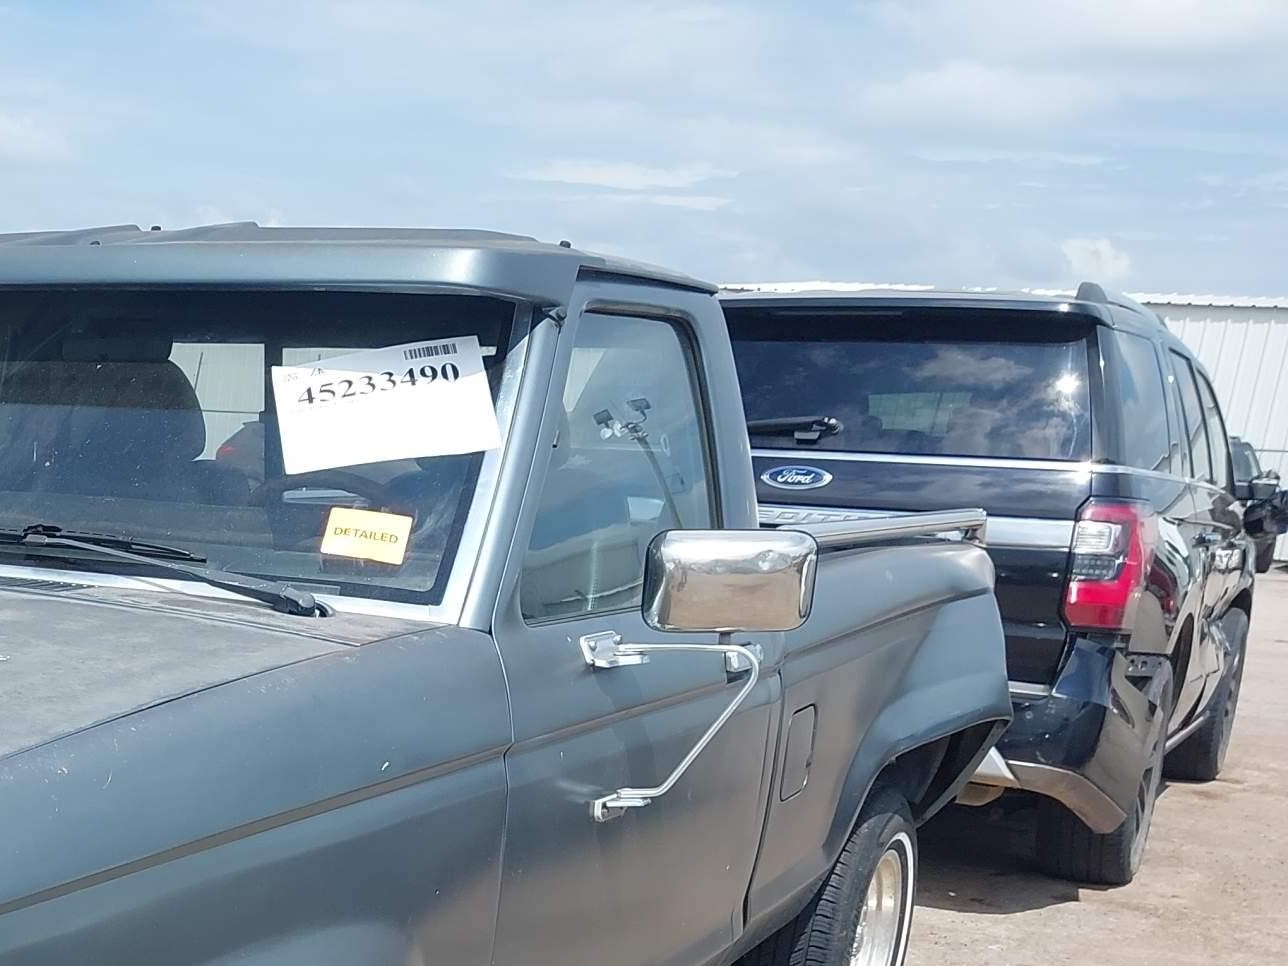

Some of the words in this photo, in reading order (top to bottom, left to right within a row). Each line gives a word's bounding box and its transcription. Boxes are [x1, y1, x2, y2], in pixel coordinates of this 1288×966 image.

[298, 362, 460, 404] 45233490
[777, 468, 816, 485] Ford
[334, 527, 399, 544] DETAILED
